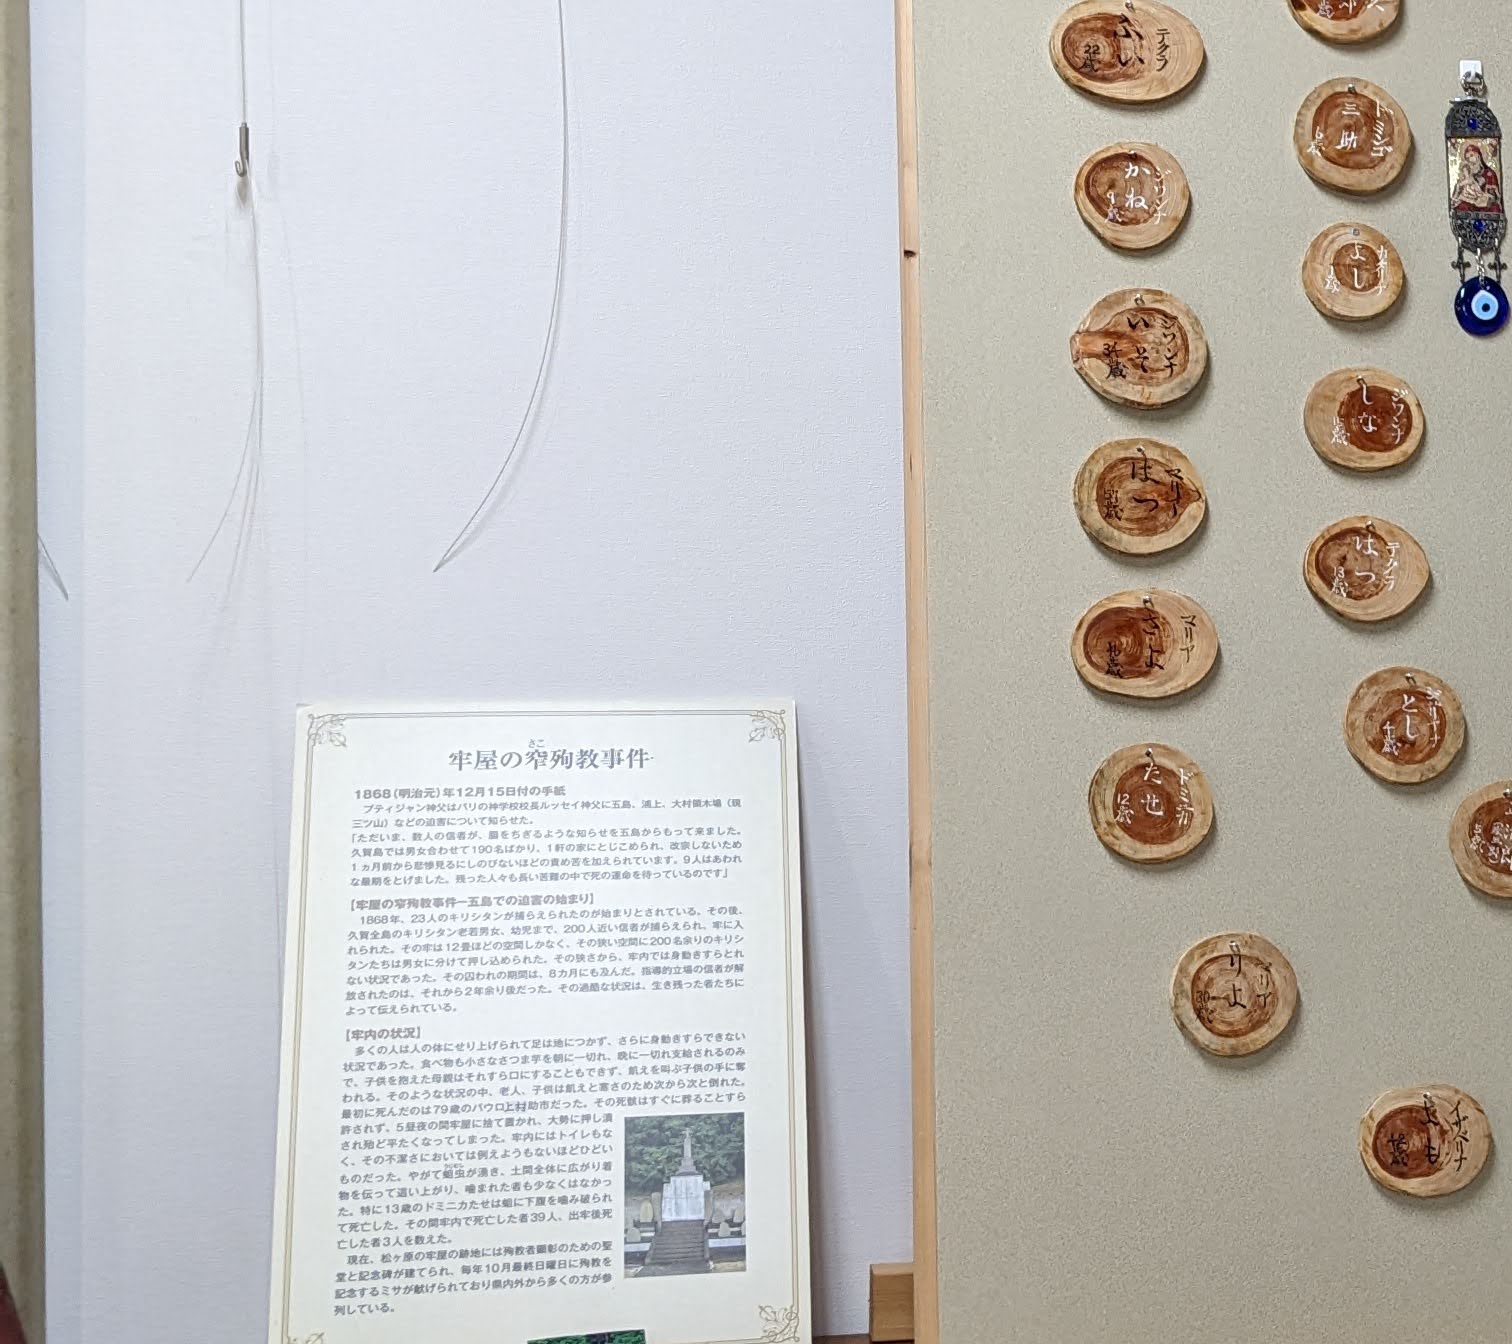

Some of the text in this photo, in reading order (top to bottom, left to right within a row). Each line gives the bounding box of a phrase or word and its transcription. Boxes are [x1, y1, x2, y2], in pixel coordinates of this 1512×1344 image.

[1156, 28, 1170, 72] テクラ
[1335, 103, 1360, 150] 三助
[1125, 162, 1151, 210] かね
[1350, 243, 1366, 289] よし
[1358, 383, 1378, 433] しな
[1131, 451, 1161, 513] はつ
[1354, 534, 1378, 585] はつ
[1384, 542, 1401, 591] テクラ
[1144, 611, 1166, 671] さよ
[1179, 615, 1196, 663] マリア
[1403, 693, 1418, 741] とし
[448, 748, 650, 772] 牢屋の窄殉教事件
[1141, 762, 1164, 816] たせ
[1228, 954, 1247, 1009] りよ
